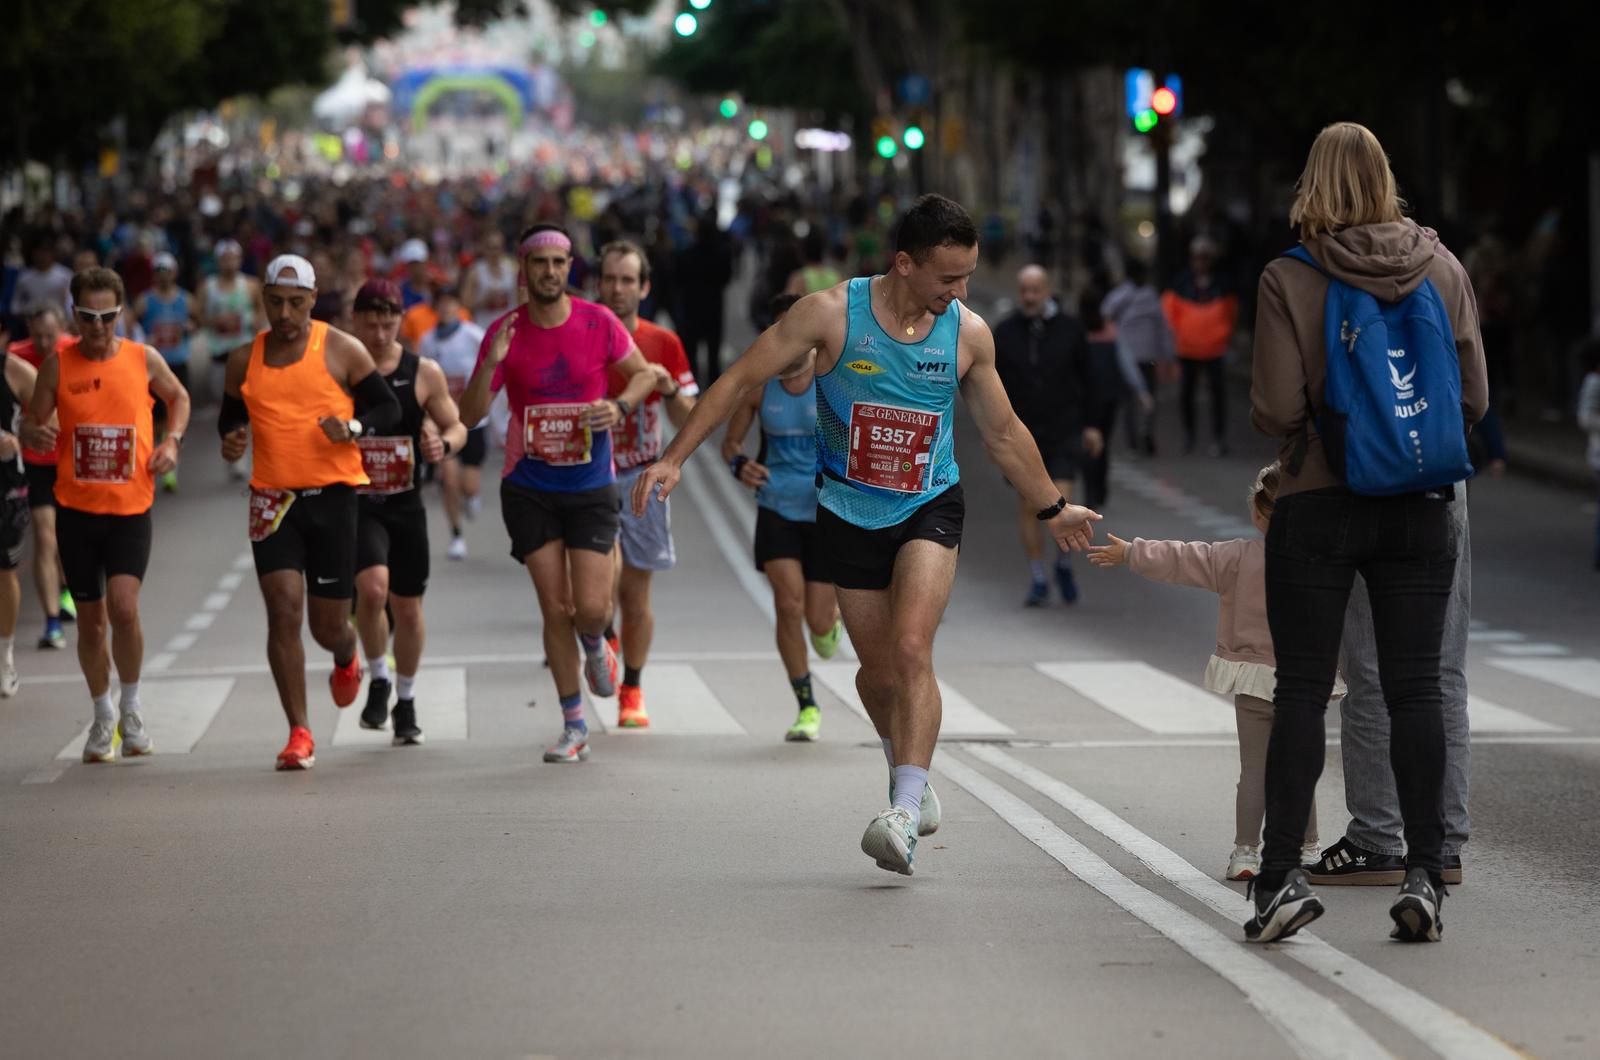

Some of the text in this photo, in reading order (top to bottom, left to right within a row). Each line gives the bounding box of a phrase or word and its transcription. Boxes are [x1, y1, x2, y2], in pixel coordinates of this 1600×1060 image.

[924, 347, 945, 356] POLI
[851, 363, 872, 371] COLAS
[917, 361, 950, 373] VMT
[876, 408, 933, 426] GENERALI
[540, 420, 573, 433] 2490
[870, 425, 916, 446] 5357
[88, 438, 117, 451] 7244
[870, 443, 911, 454] DAMIEN VEAU
[365, 451, 396, 464] 7024
